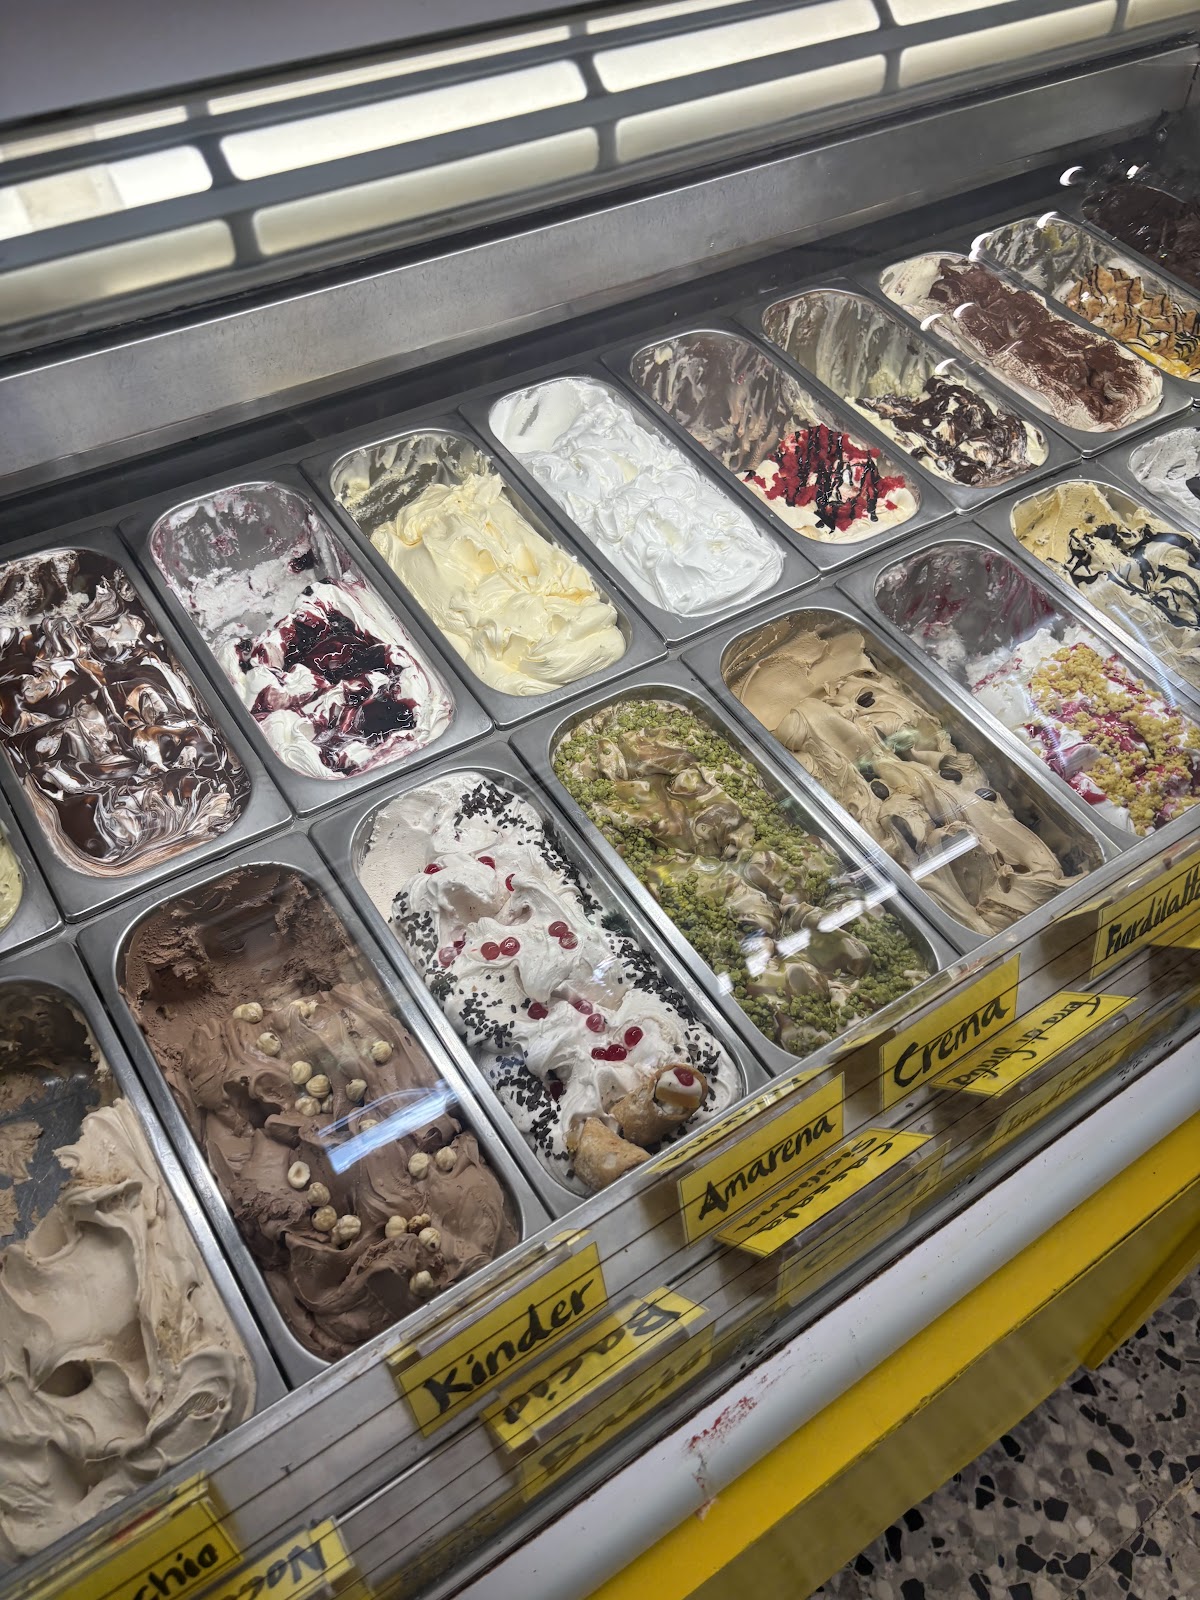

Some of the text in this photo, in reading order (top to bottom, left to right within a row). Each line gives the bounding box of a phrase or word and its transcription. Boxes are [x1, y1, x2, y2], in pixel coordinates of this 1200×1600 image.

[893, 994, 1010, 1088] Crema
[947, 997, 1101, 1086] Terra di Sicilia
[698, 1114, 836, 1220] Amarena
[733, 1137, 877, 1234] Siciliana
[422, 1279, 594, 1415] Kinder
[503, 1298, 682, 1424] Bacio
